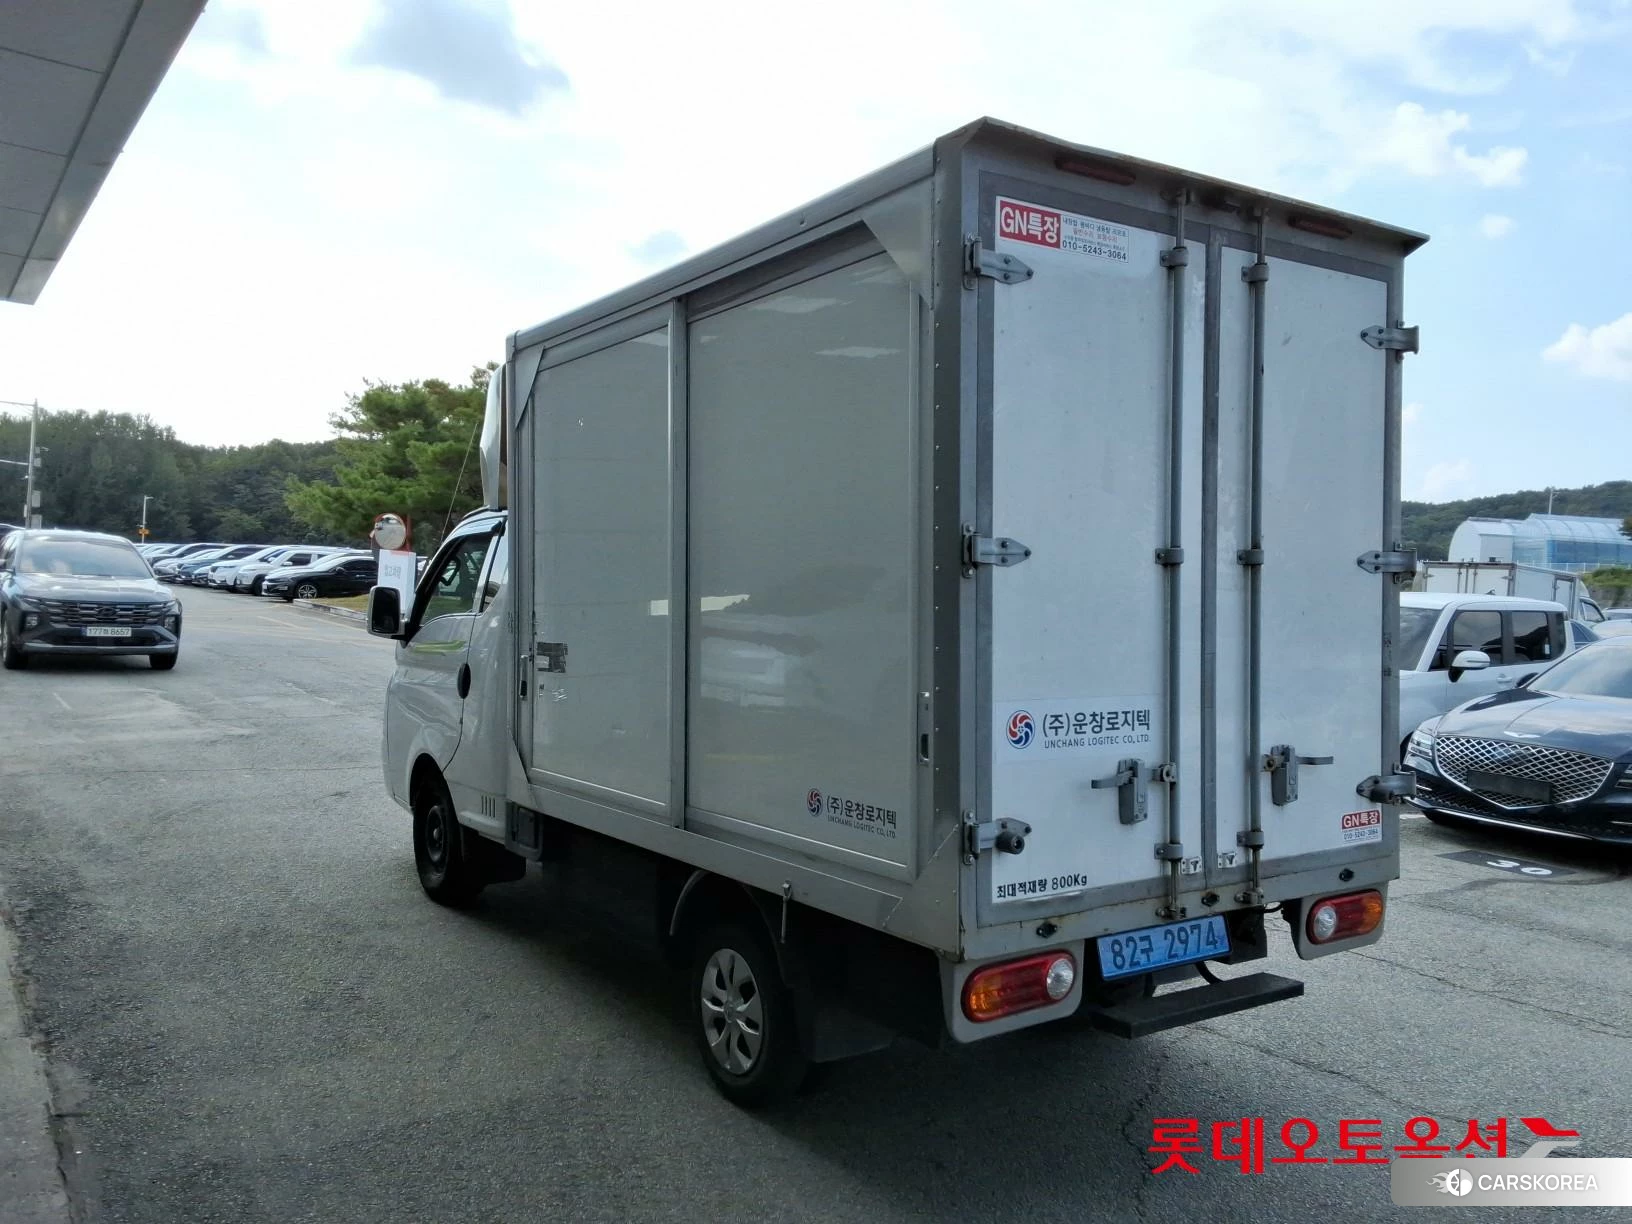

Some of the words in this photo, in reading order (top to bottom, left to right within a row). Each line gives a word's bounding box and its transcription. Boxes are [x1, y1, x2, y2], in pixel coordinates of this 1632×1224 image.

[1001, 206, 1060, 244] GN특장
[1062, 240, 1126, 260] 010-5243-3064
[1042, 709, 1150, 738] (주)운창로지텍
[1044, 737, 1085, 749] UNCHANG
[1088, 735, 1120, 746] LOGITEC
[826, 795, 897, 830] (주)운창로지텍
[1343, 811, 1378, 828] GN특장
[997, 878, 1048, 898] 최대적재량
[1051, 873, 1088, 890] 800Kg
[1110, 935, 1154, 970] 82구
[1163, 920, 1219, 960] 2974
